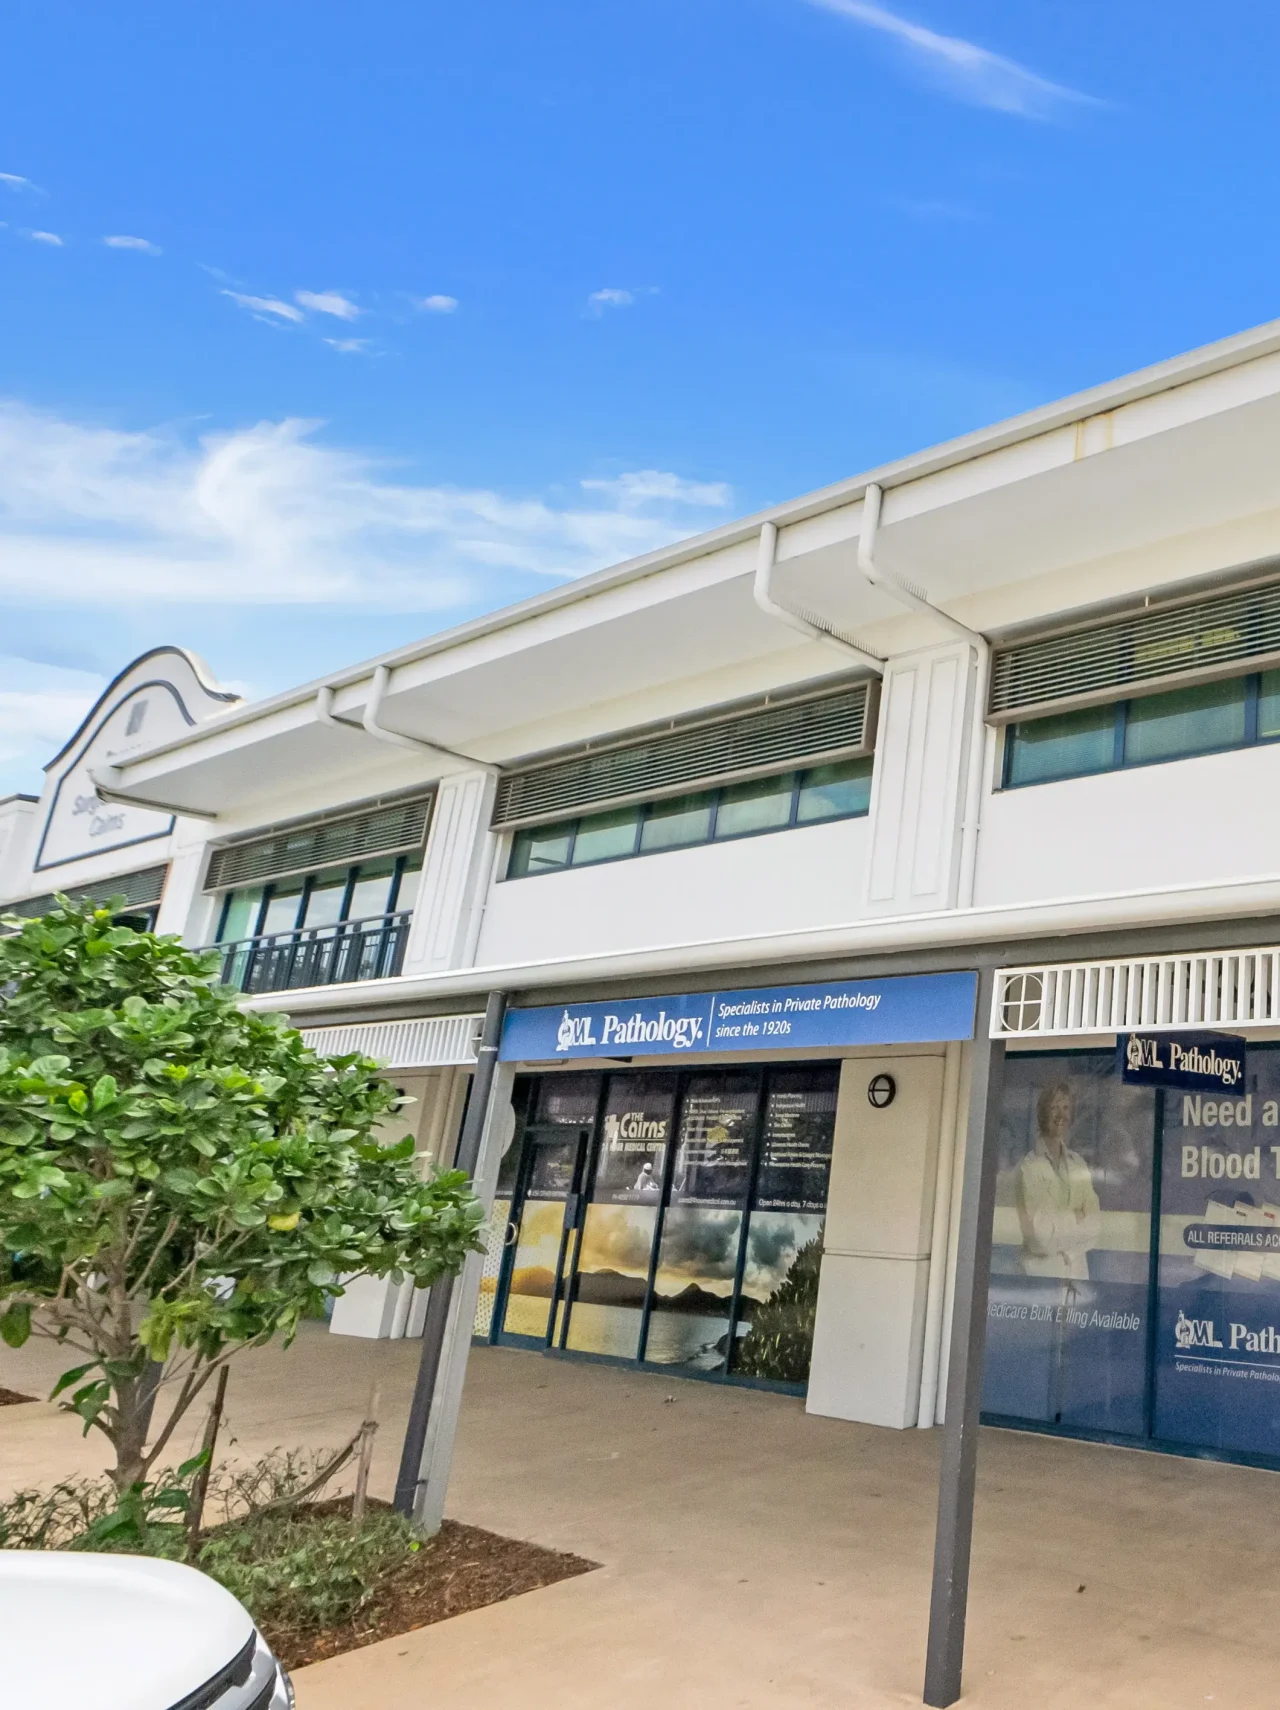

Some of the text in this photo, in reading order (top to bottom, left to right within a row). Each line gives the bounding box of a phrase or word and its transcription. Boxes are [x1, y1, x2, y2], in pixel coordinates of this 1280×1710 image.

[718, 992, 881, 1019] Specialists in Private Pathology
[600, 1011, 703, 1048] Pathology.
[715, 1020, 792, 1037] since the 1920s
[1169, 1042, 1242, 1085] Pathology.
[631, 1112, 644, 1122] THE
[1182, 1094, 1279, 1127] Need a
[620, 1112, 667, 1138] Cairns
[1181, 1145, 1261, 1180] Blood
[1188, 1230, 1205, 1243] ALL
[1207, 1232, 1263, 1246] REFERRALS
[1030, 1304, 1053, 1322] Bulk
[1056, 1308, 1089, 1328] Blling
[1090, 1310, 1140, 1331] Available
[1175, 1362, 1213, 1375] Specialists
[1214, 1368, 1222, 1376] in
[1223, 1368, 1249, 1379] Private
